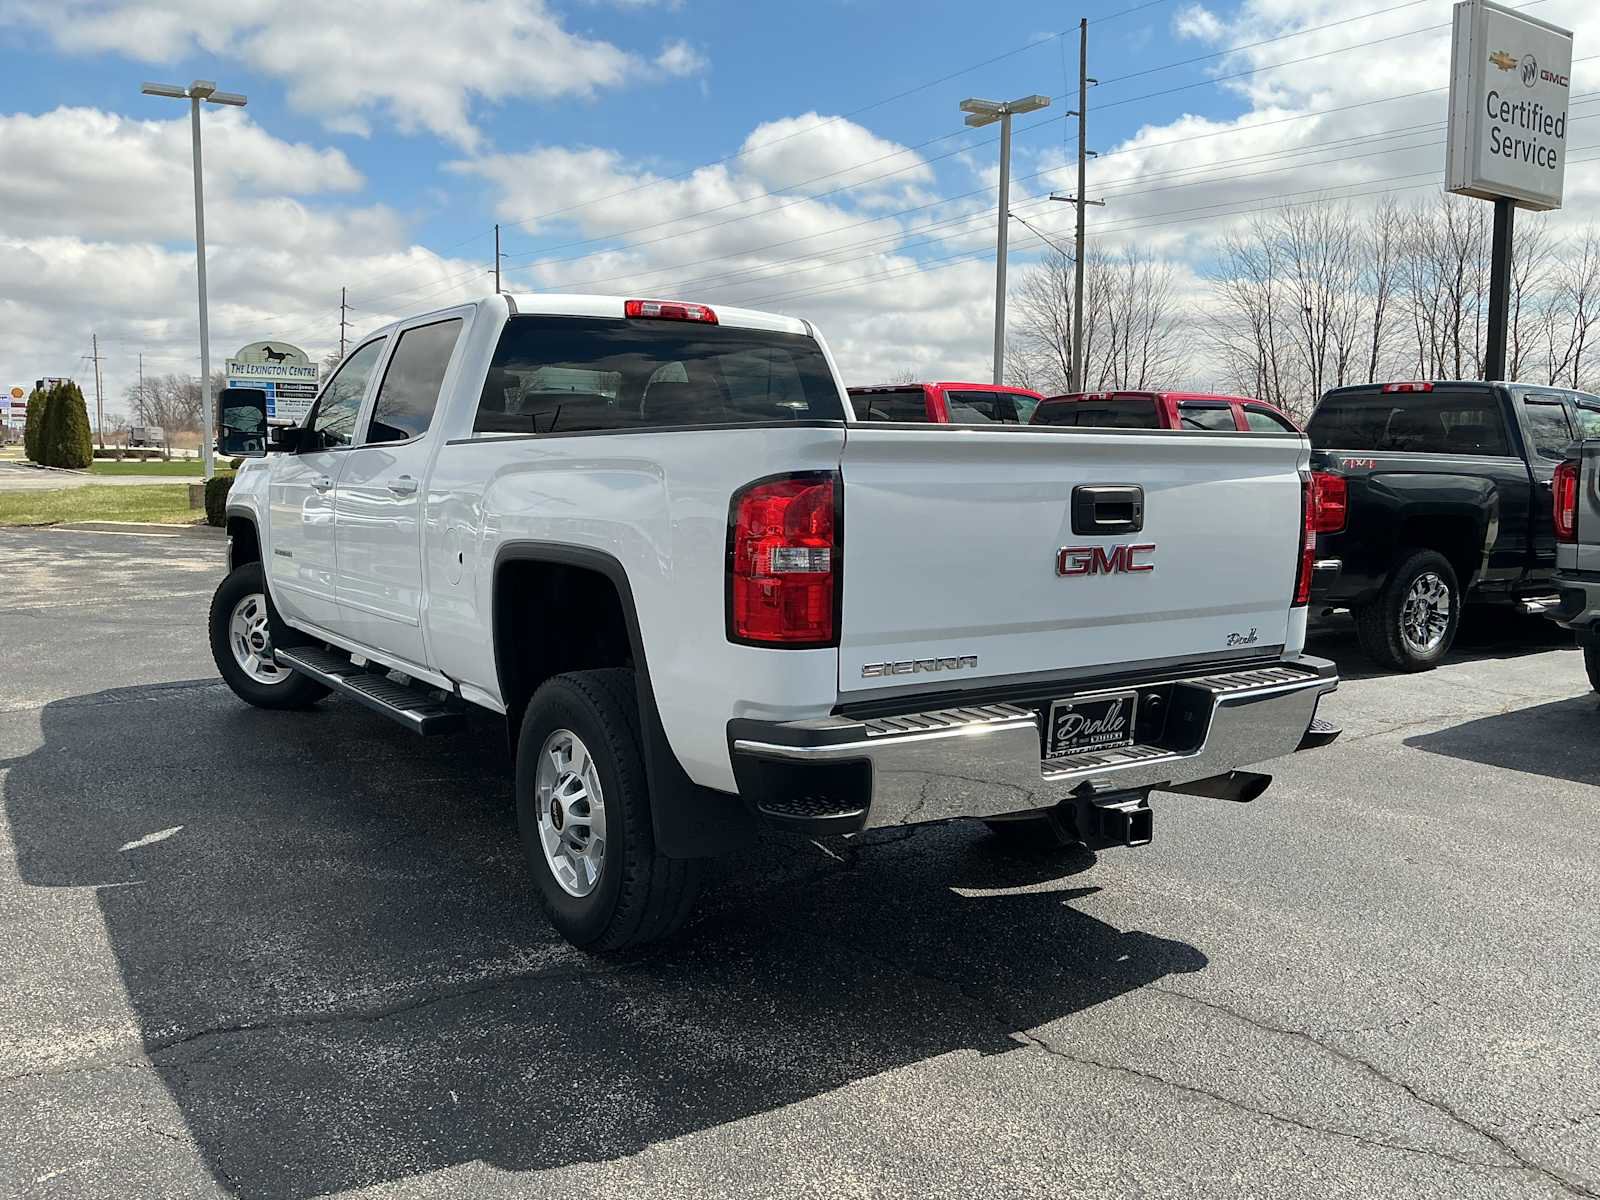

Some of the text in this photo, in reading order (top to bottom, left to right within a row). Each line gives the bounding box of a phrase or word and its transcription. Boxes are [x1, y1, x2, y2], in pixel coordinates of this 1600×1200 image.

[1540, 69, 1569, 87] GMC
[1486, 90, 1565, 139] Certified
[1490, 126, 1557, 170] Service
[231, 364, 316, 377] THE LEXINGTON CENTRE
[1055, 542, 1157, 578] GMC
[1226, 628, 1258, 647] Dralle
[861, 654, 979, 679] SIERRA
[1057, 702, 1126, 740] Dralle
